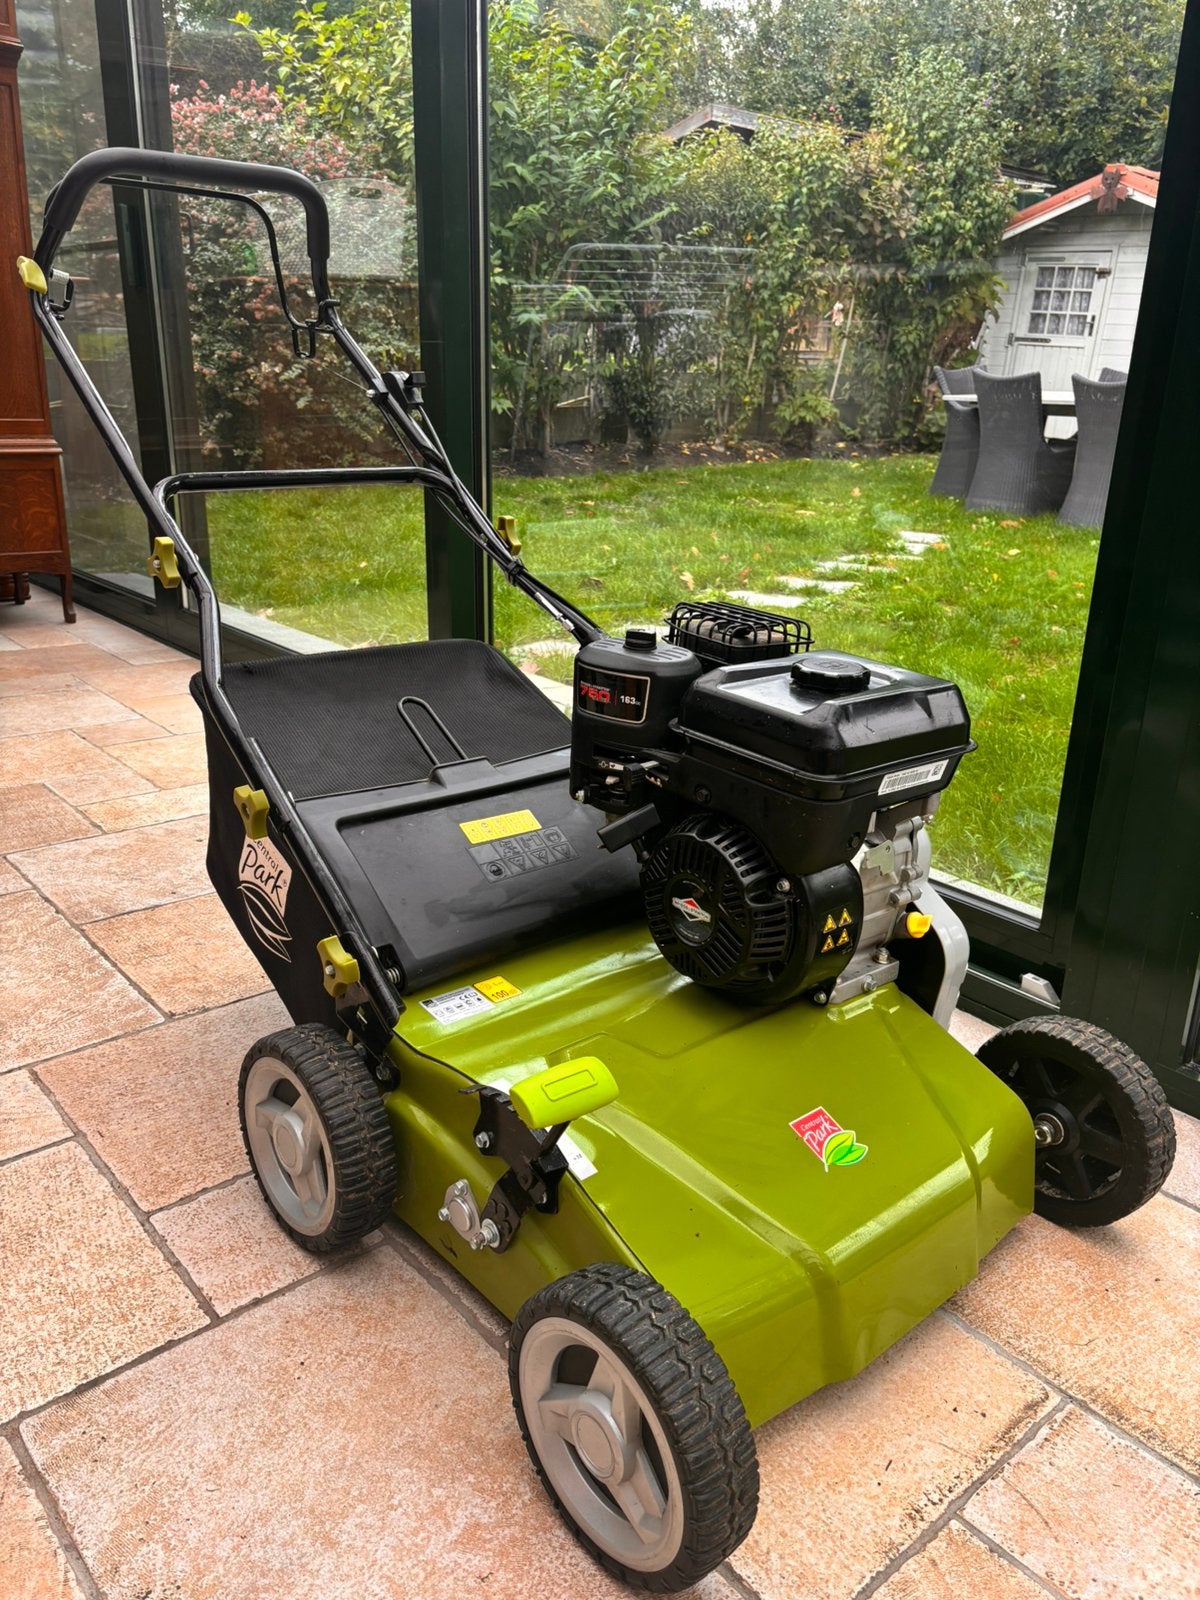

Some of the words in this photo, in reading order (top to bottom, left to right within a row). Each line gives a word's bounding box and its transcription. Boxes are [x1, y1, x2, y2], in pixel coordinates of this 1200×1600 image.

[254, 840, 279, 872] entral
[241, 843, 283, 908] Park
[491, 989, 509, 1000] 100
[800, 1115, 822, 1132] Central
[804, 1115, 839, 1153] Park
